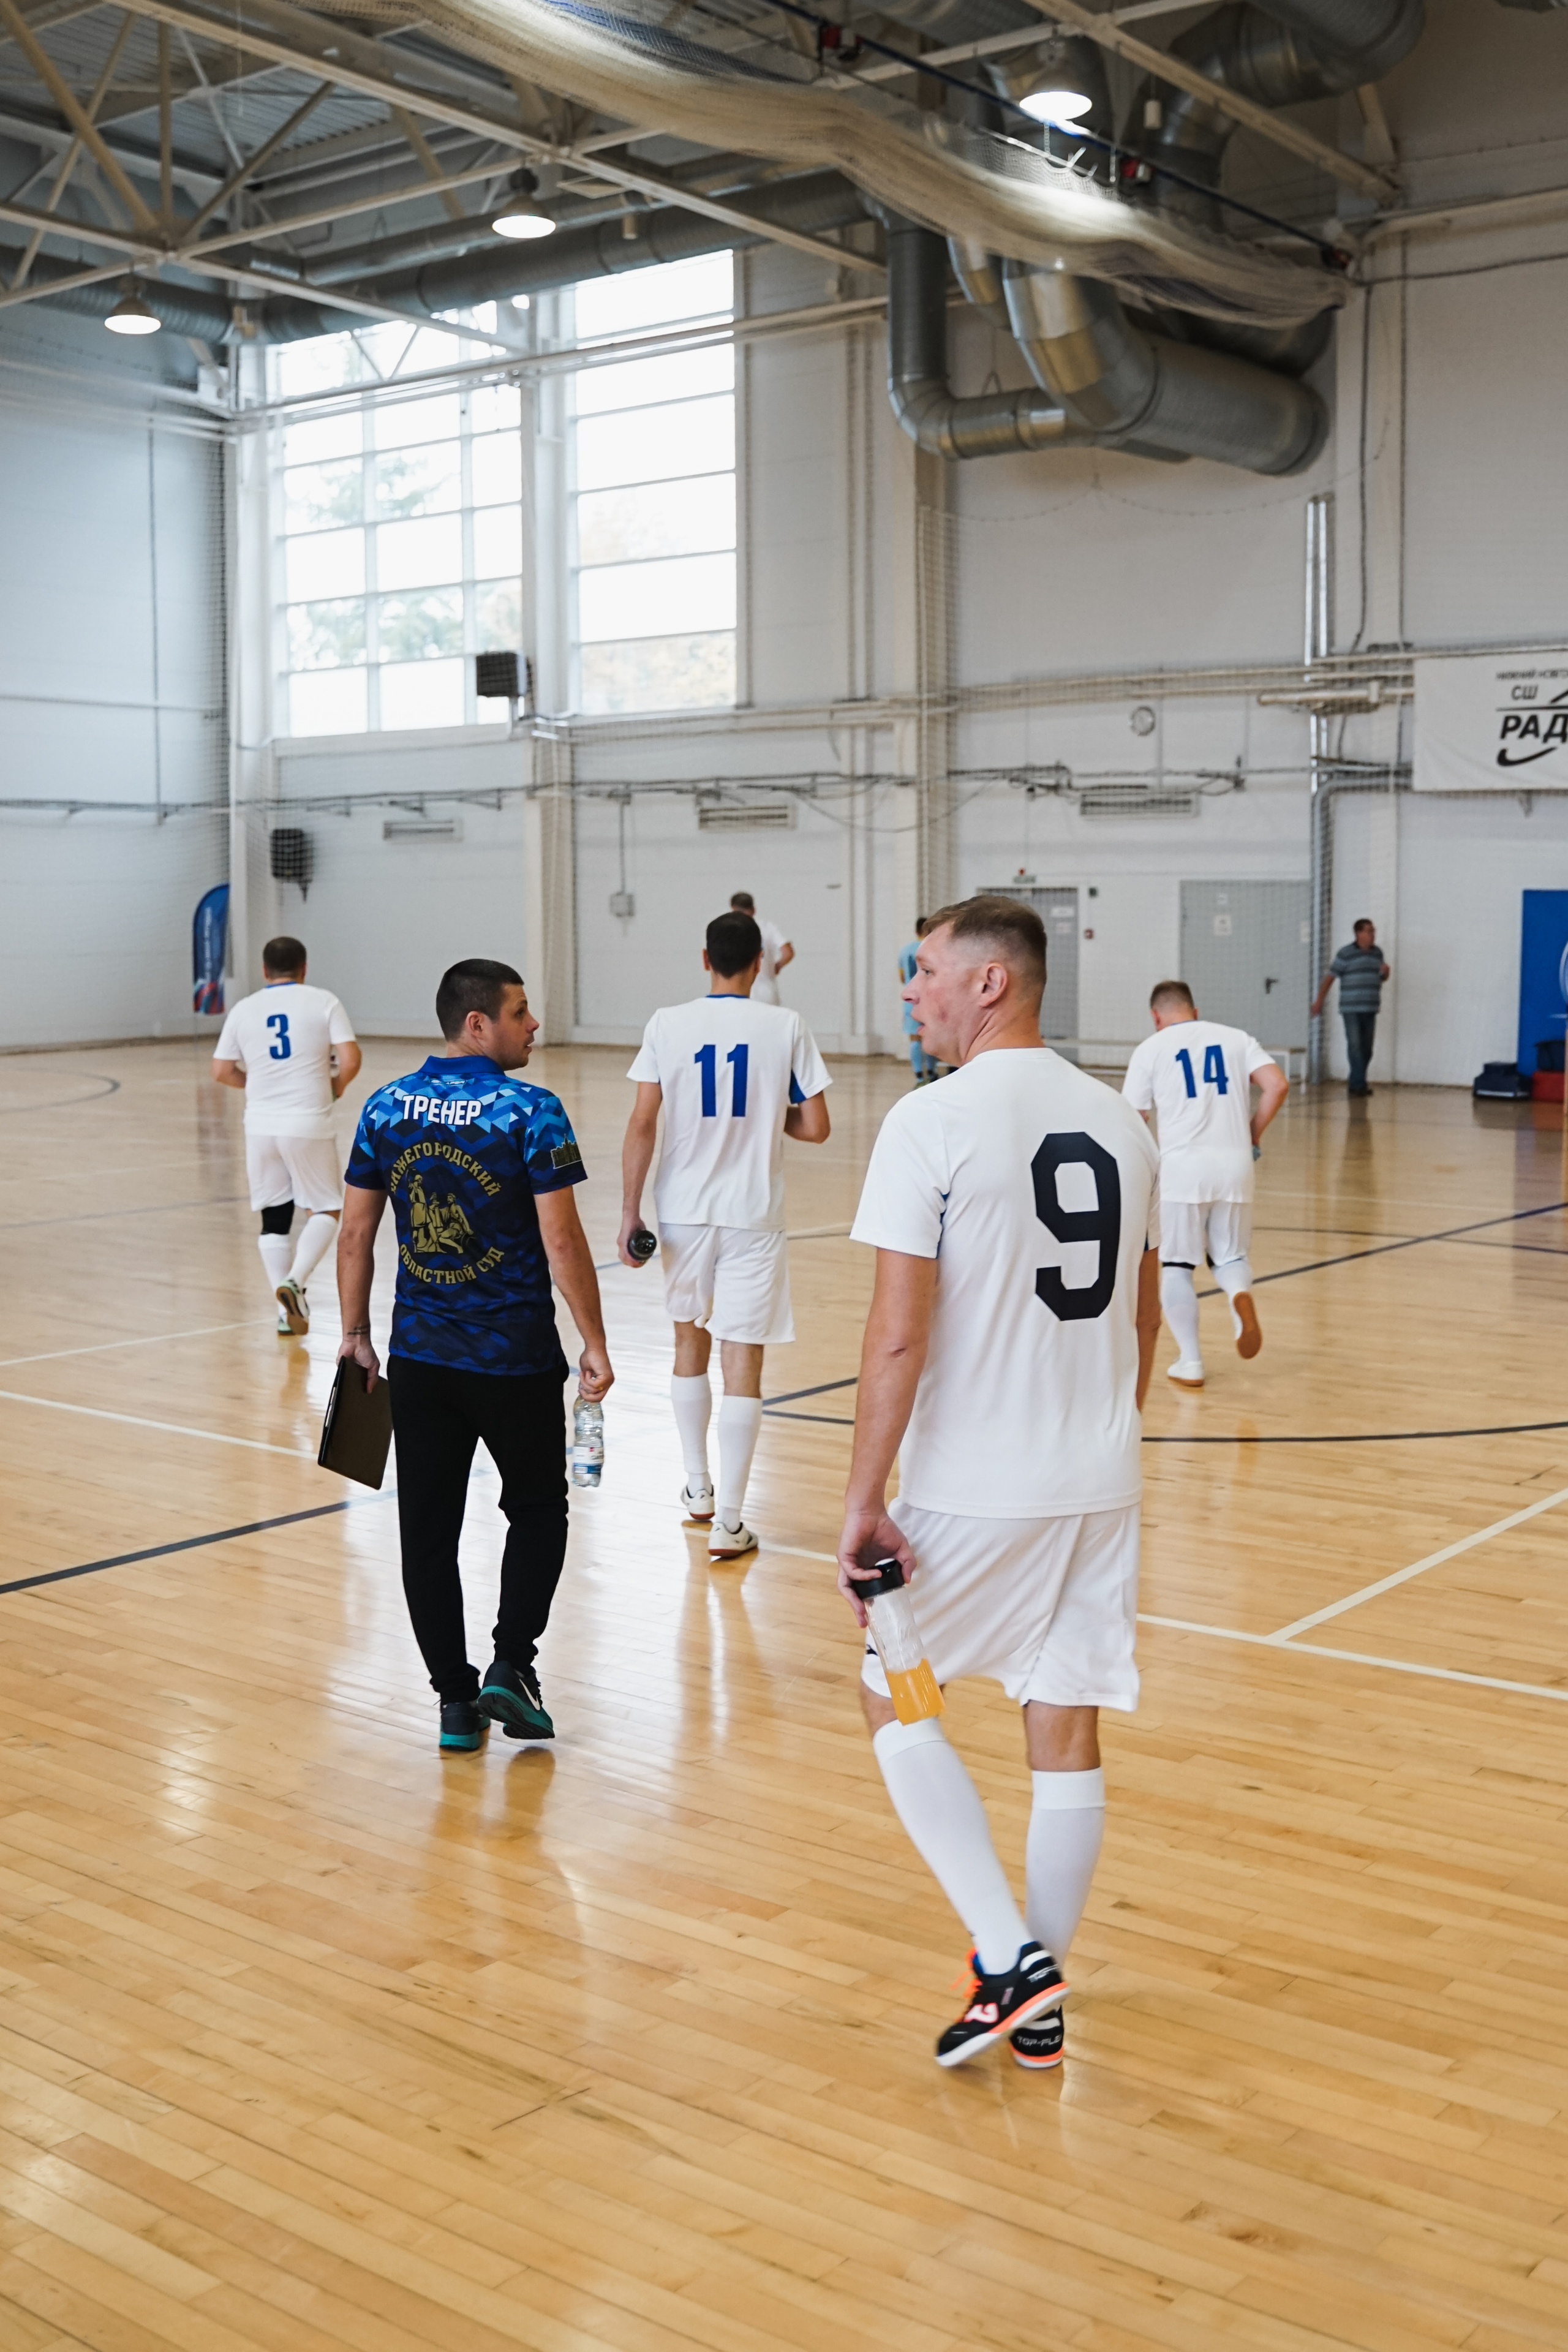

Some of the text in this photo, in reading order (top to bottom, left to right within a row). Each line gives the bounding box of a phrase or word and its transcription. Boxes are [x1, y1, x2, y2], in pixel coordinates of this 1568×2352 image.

[1511, 684, 1539, 700] СШ
[266, 1014, 291, 1060] 3
[694, 1044, 749, 1117] 11
[1175, 1044, 1229, 1098] 14
[401, 1094, 483, 1126] ТРЕНЕР
[1030, 1131, 1121, 1322] 9
[400, 1243, 505, 1284] ОБЛАСТНОЙ СУД
